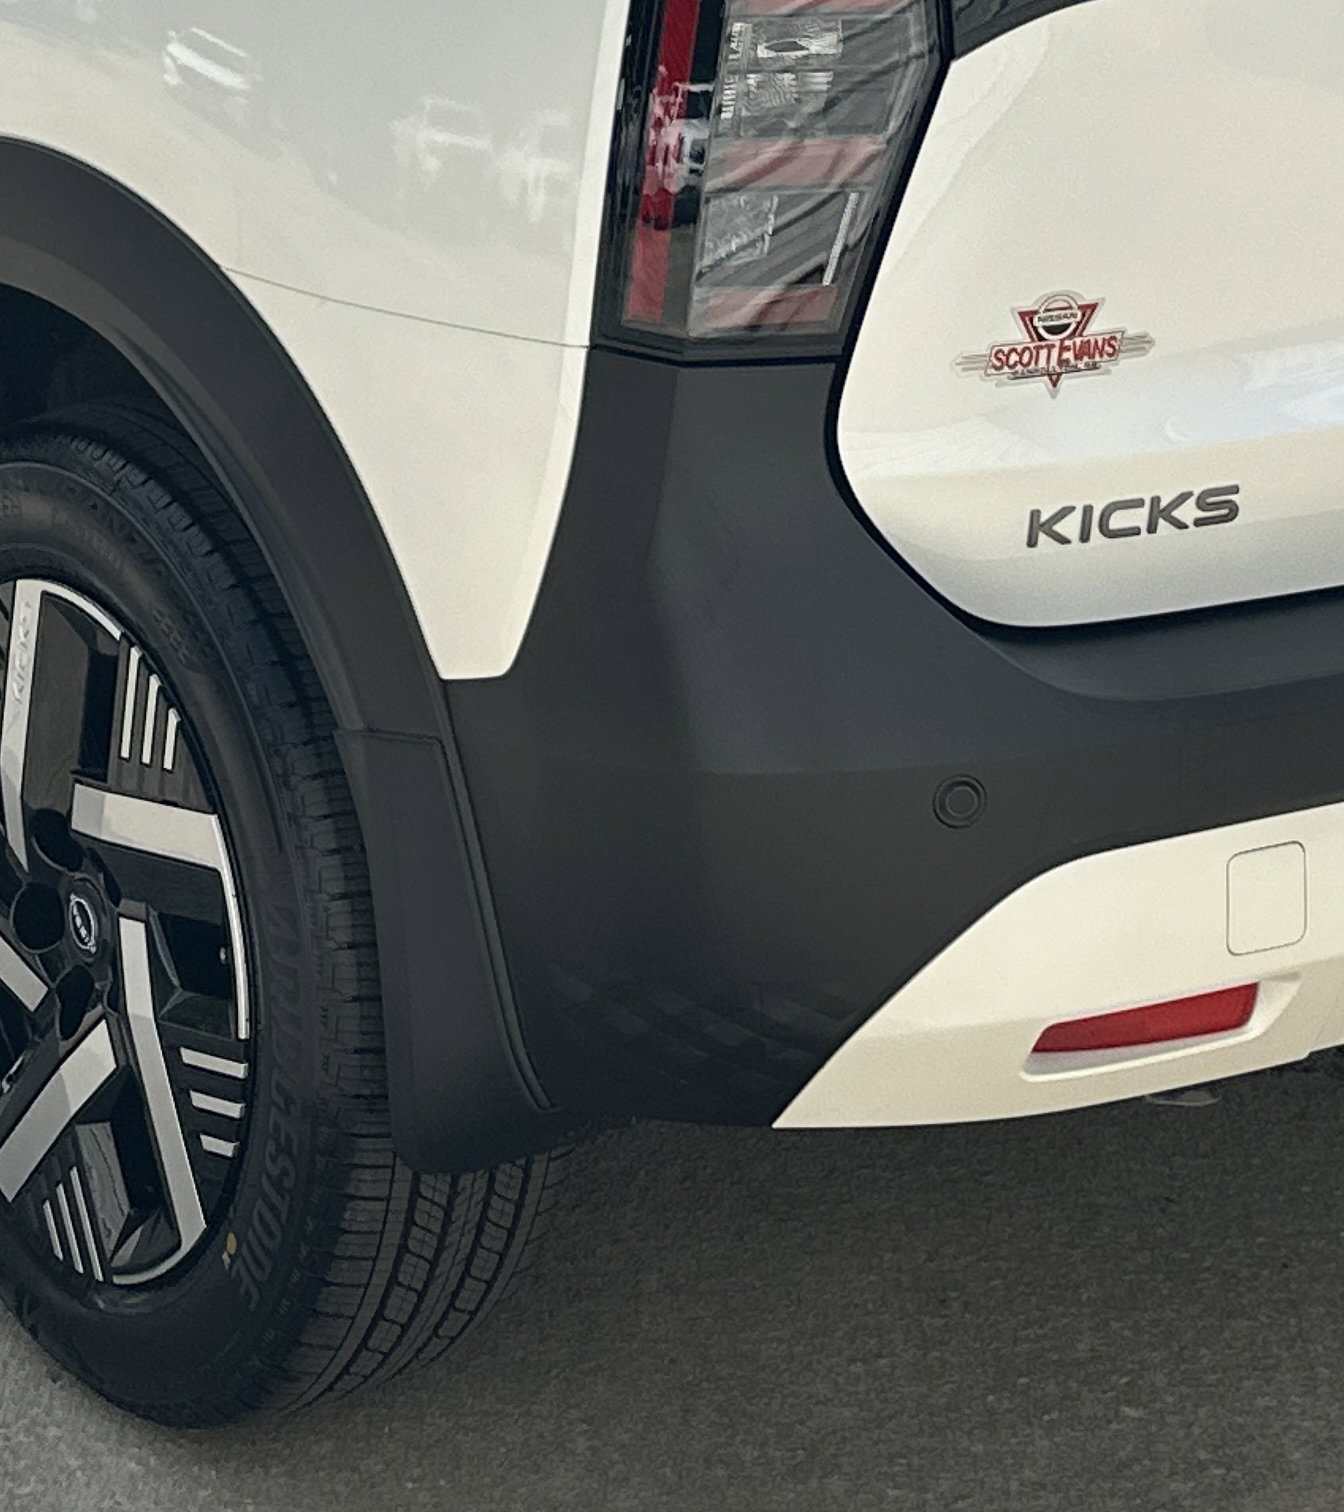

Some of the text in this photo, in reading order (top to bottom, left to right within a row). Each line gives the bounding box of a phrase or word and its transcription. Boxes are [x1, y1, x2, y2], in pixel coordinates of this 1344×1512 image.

[991, 343, 1056, 371] SCOTT
[1056, 335, 1118, 368] EVANS
[1025, 484, 1240, 549] KICKS
